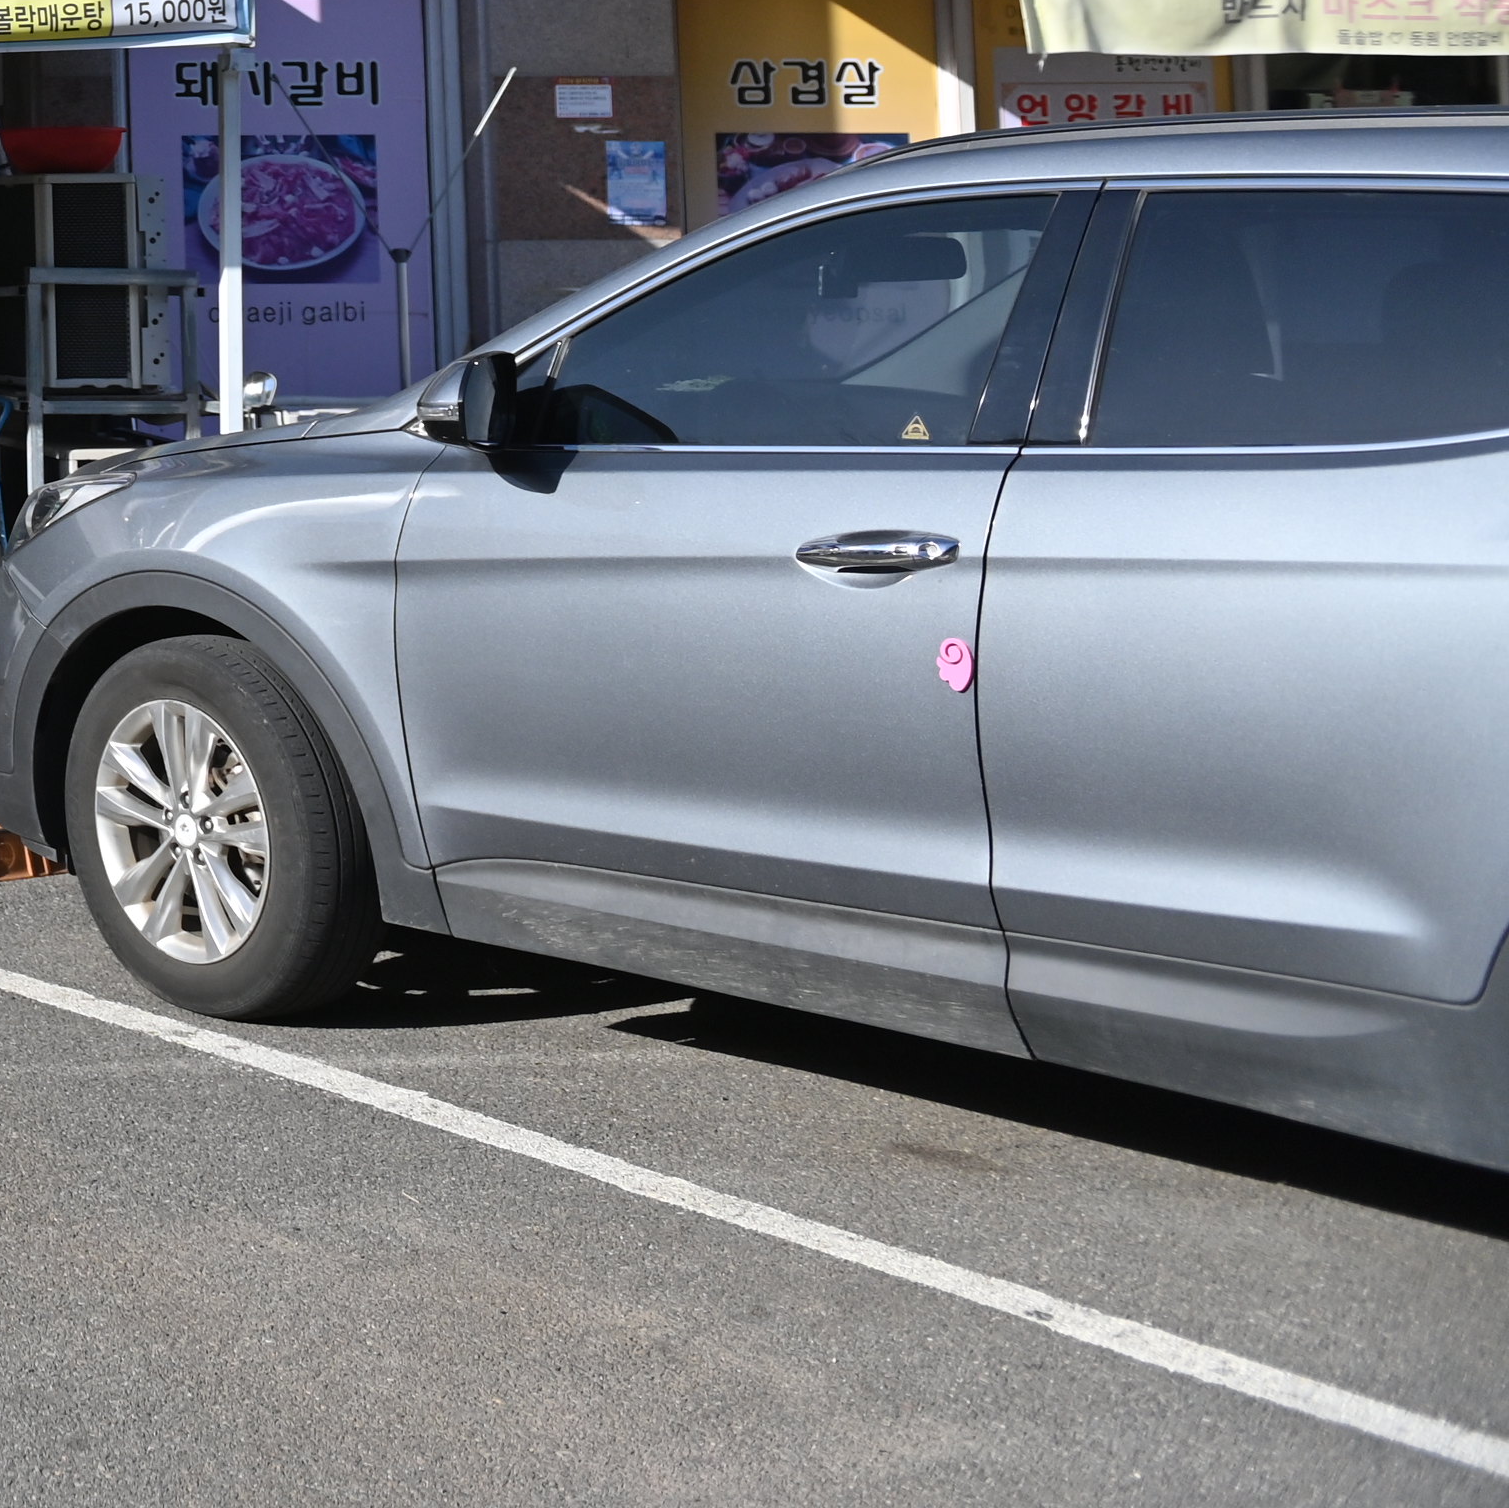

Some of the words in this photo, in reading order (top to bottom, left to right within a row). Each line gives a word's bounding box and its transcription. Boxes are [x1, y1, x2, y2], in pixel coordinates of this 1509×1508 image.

[730, 59, 883, 107] 삼겹살
[1016, 92, 1193, 124] 언양갈비
[209, 301, 292, 325] aeji
[302, 301, 366, 325] galbi
